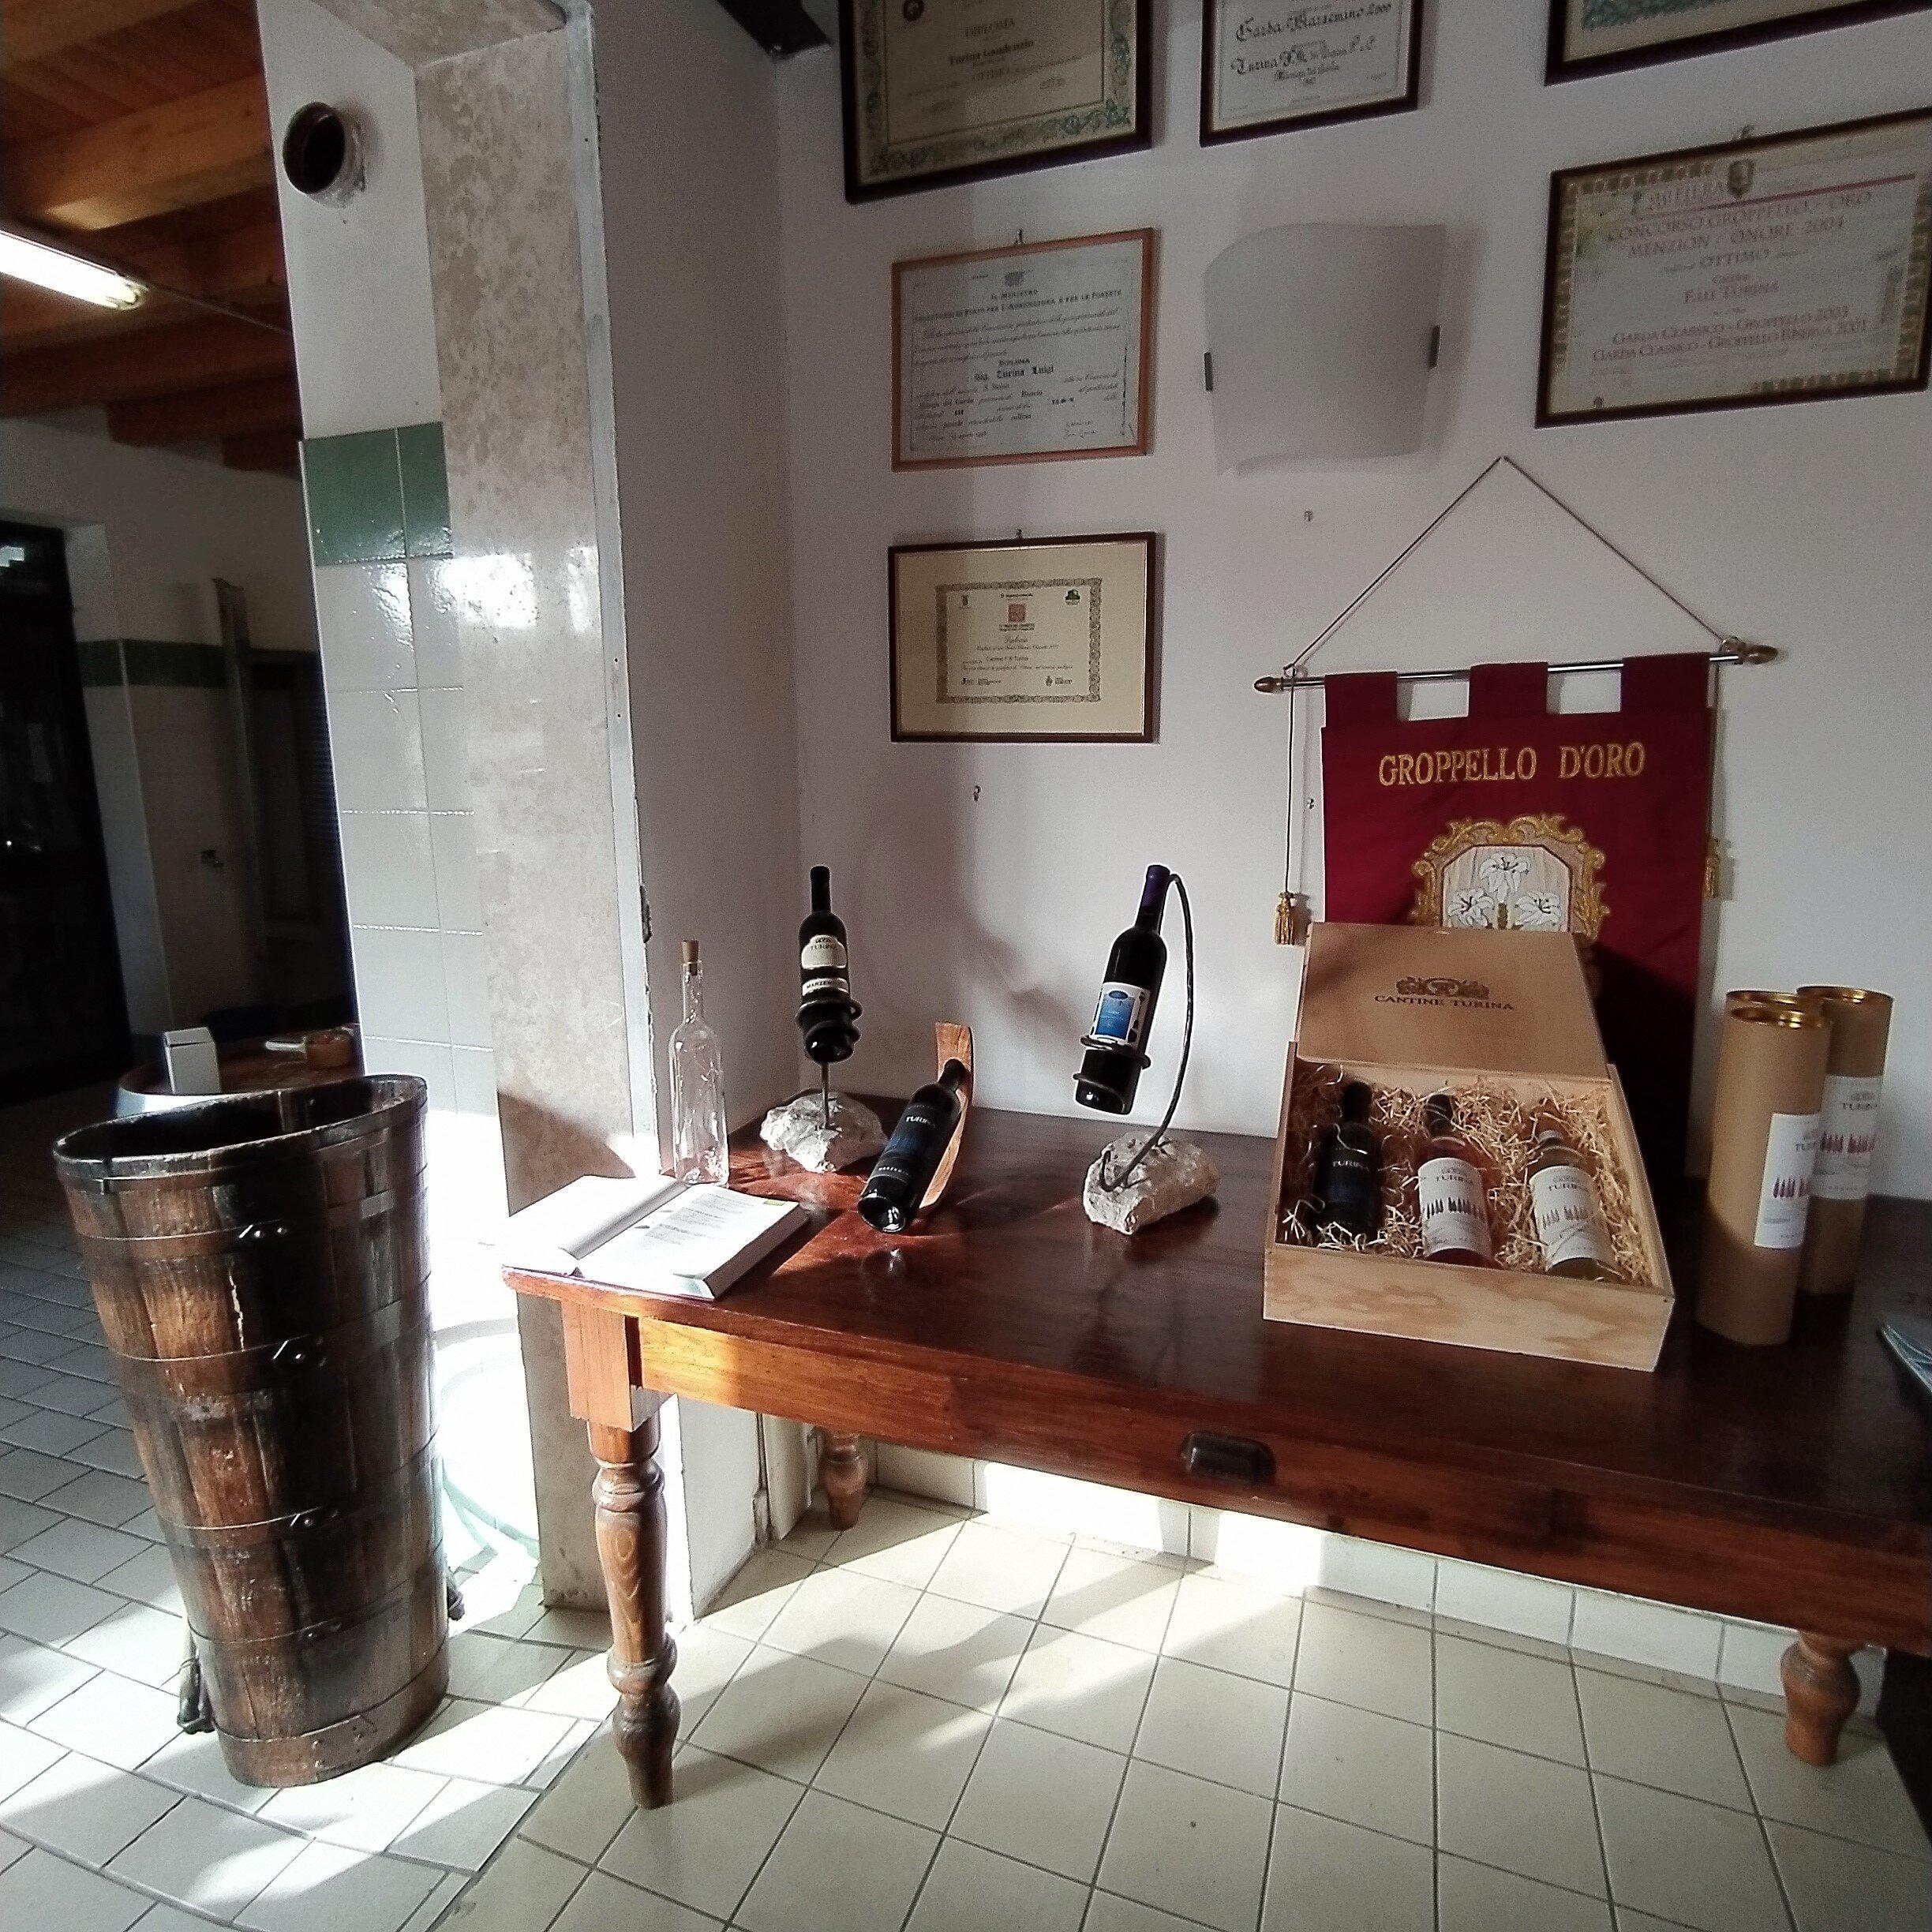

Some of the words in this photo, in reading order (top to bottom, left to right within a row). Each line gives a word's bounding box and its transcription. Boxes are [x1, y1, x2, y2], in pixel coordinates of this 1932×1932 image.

[1379, 747, 1537, 786] GROPPELLO
[1558, 742, 1646, 779] D'ORO
[1374, 995, 1444, 1006] CANTINE
[1452, 999, 1515, 1010] TURINA
